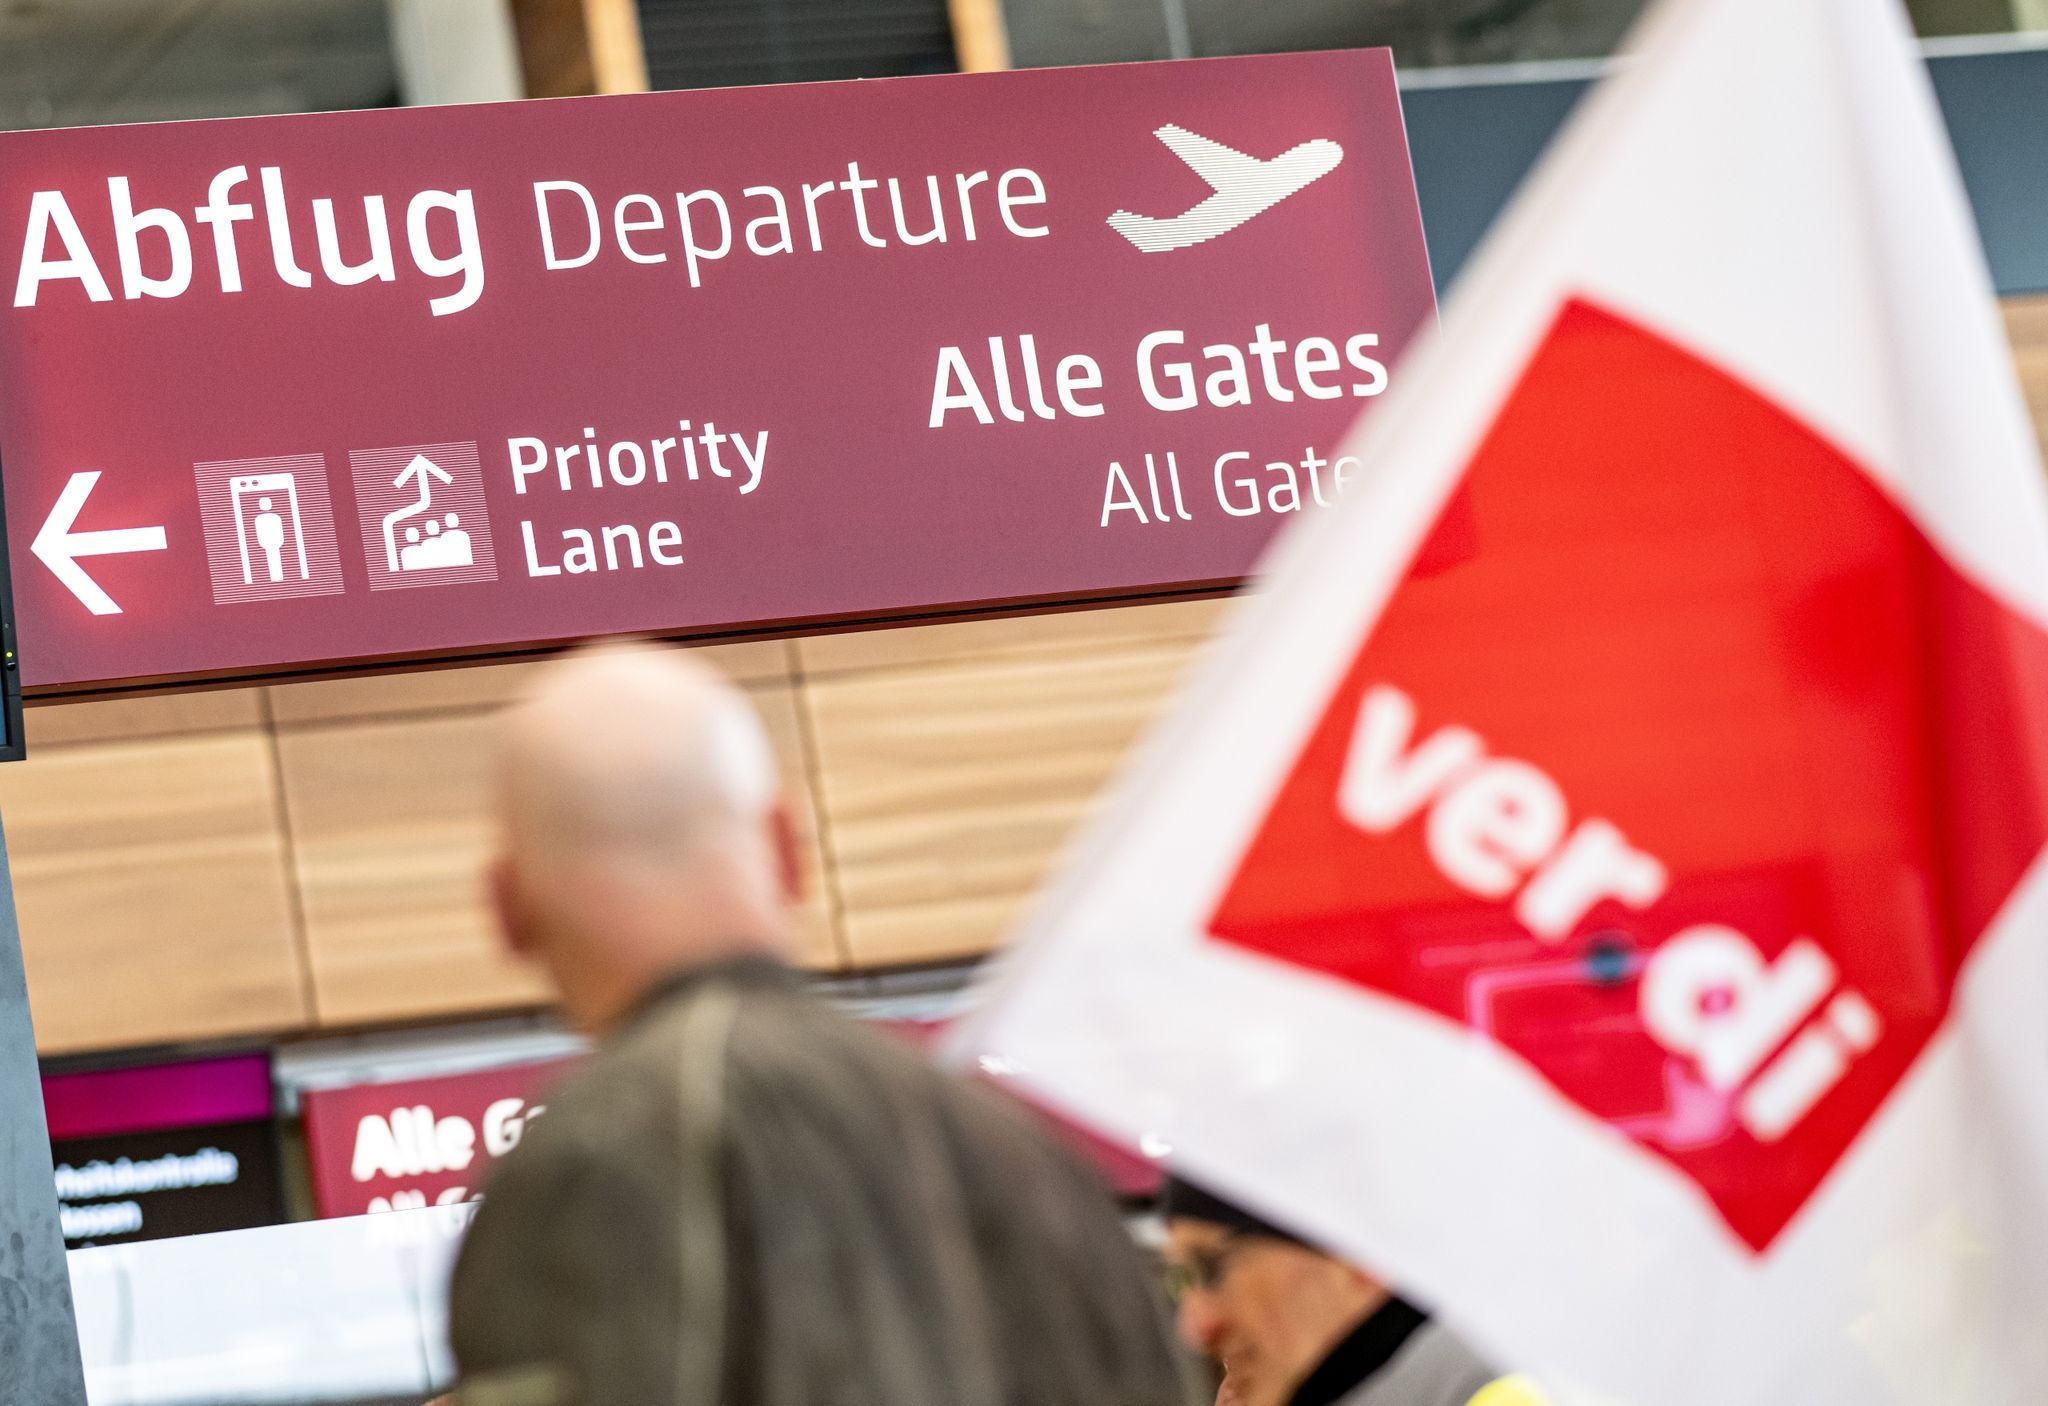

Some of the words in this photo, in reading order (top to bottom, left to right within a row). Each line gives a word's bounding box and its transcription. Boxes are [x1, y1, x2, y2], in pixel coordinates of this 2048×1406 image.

[13, 165, 485, 317] Abflug
[533, 161, 1050, 288] Departure
[928, 333, 1105, 428] Alle
[1136, 323, 1389, 412] Gates
[507, 419, 769, 495] Priority
[1100, 451, 1192, 528] All
[1213, 446, 1364, 517] Gate
[520, 520, 684, 578] Lane
[351, 1104, 476, 1183] Alle
